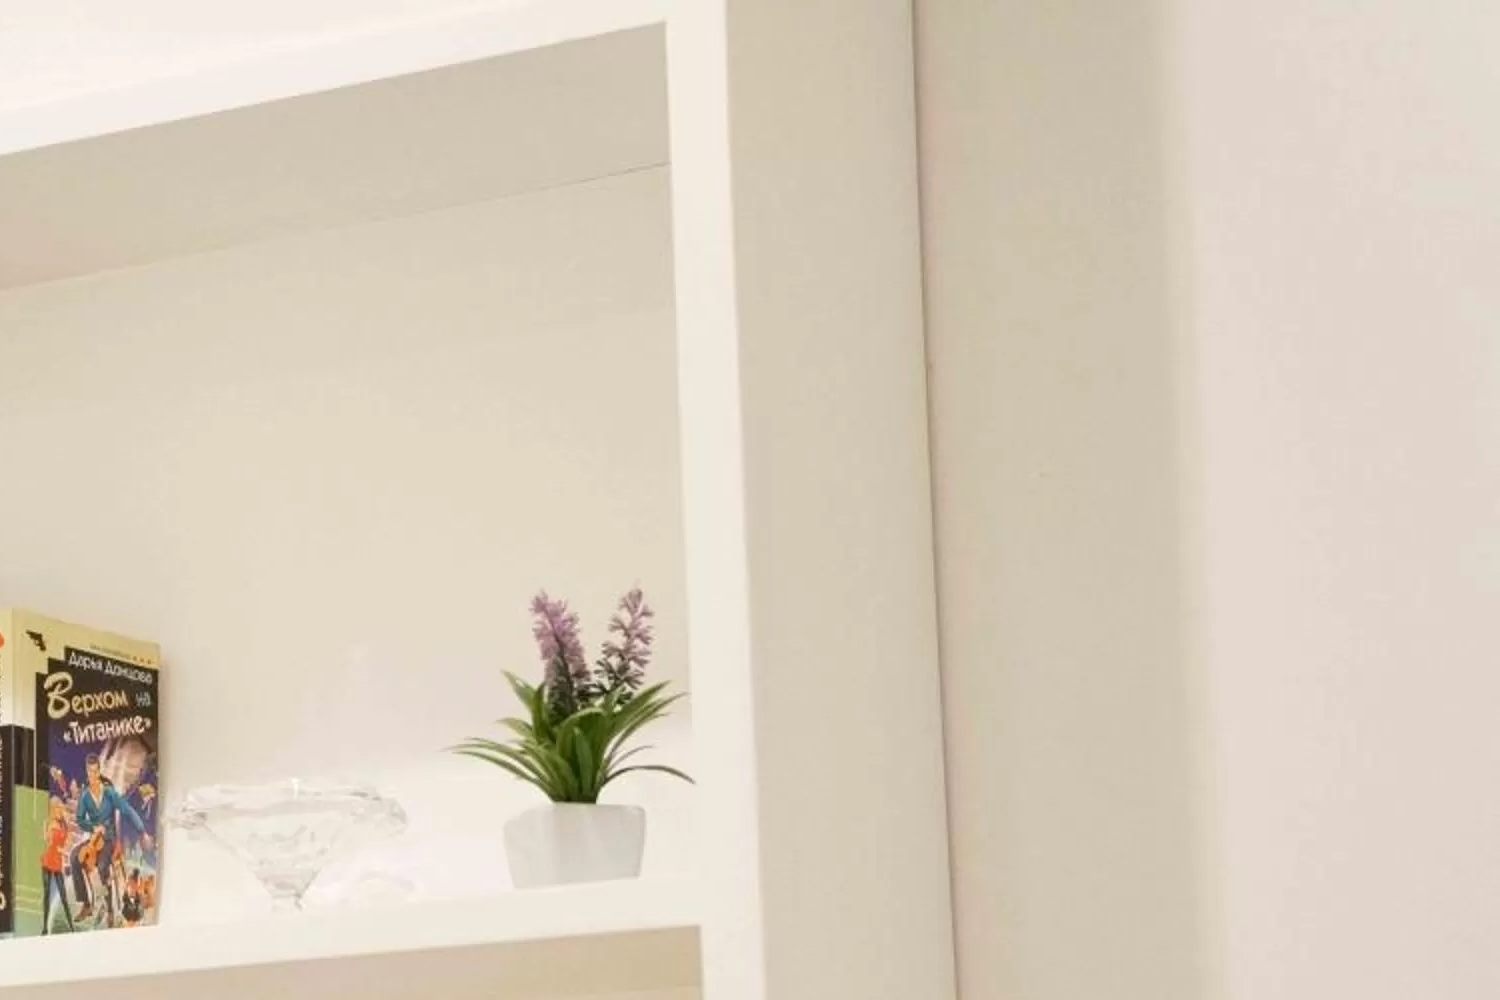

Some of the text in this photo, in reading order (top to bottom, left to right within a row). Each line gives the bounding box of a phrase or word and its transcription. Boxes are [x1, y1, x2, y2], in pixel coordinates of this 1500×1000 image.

[68, 651, 103, 672] Дарья
[104, 660, 153, 685] Донцова
[44, 671, 151, 719] Верхом на
[63, 715, 152, 745] «Титанике»
